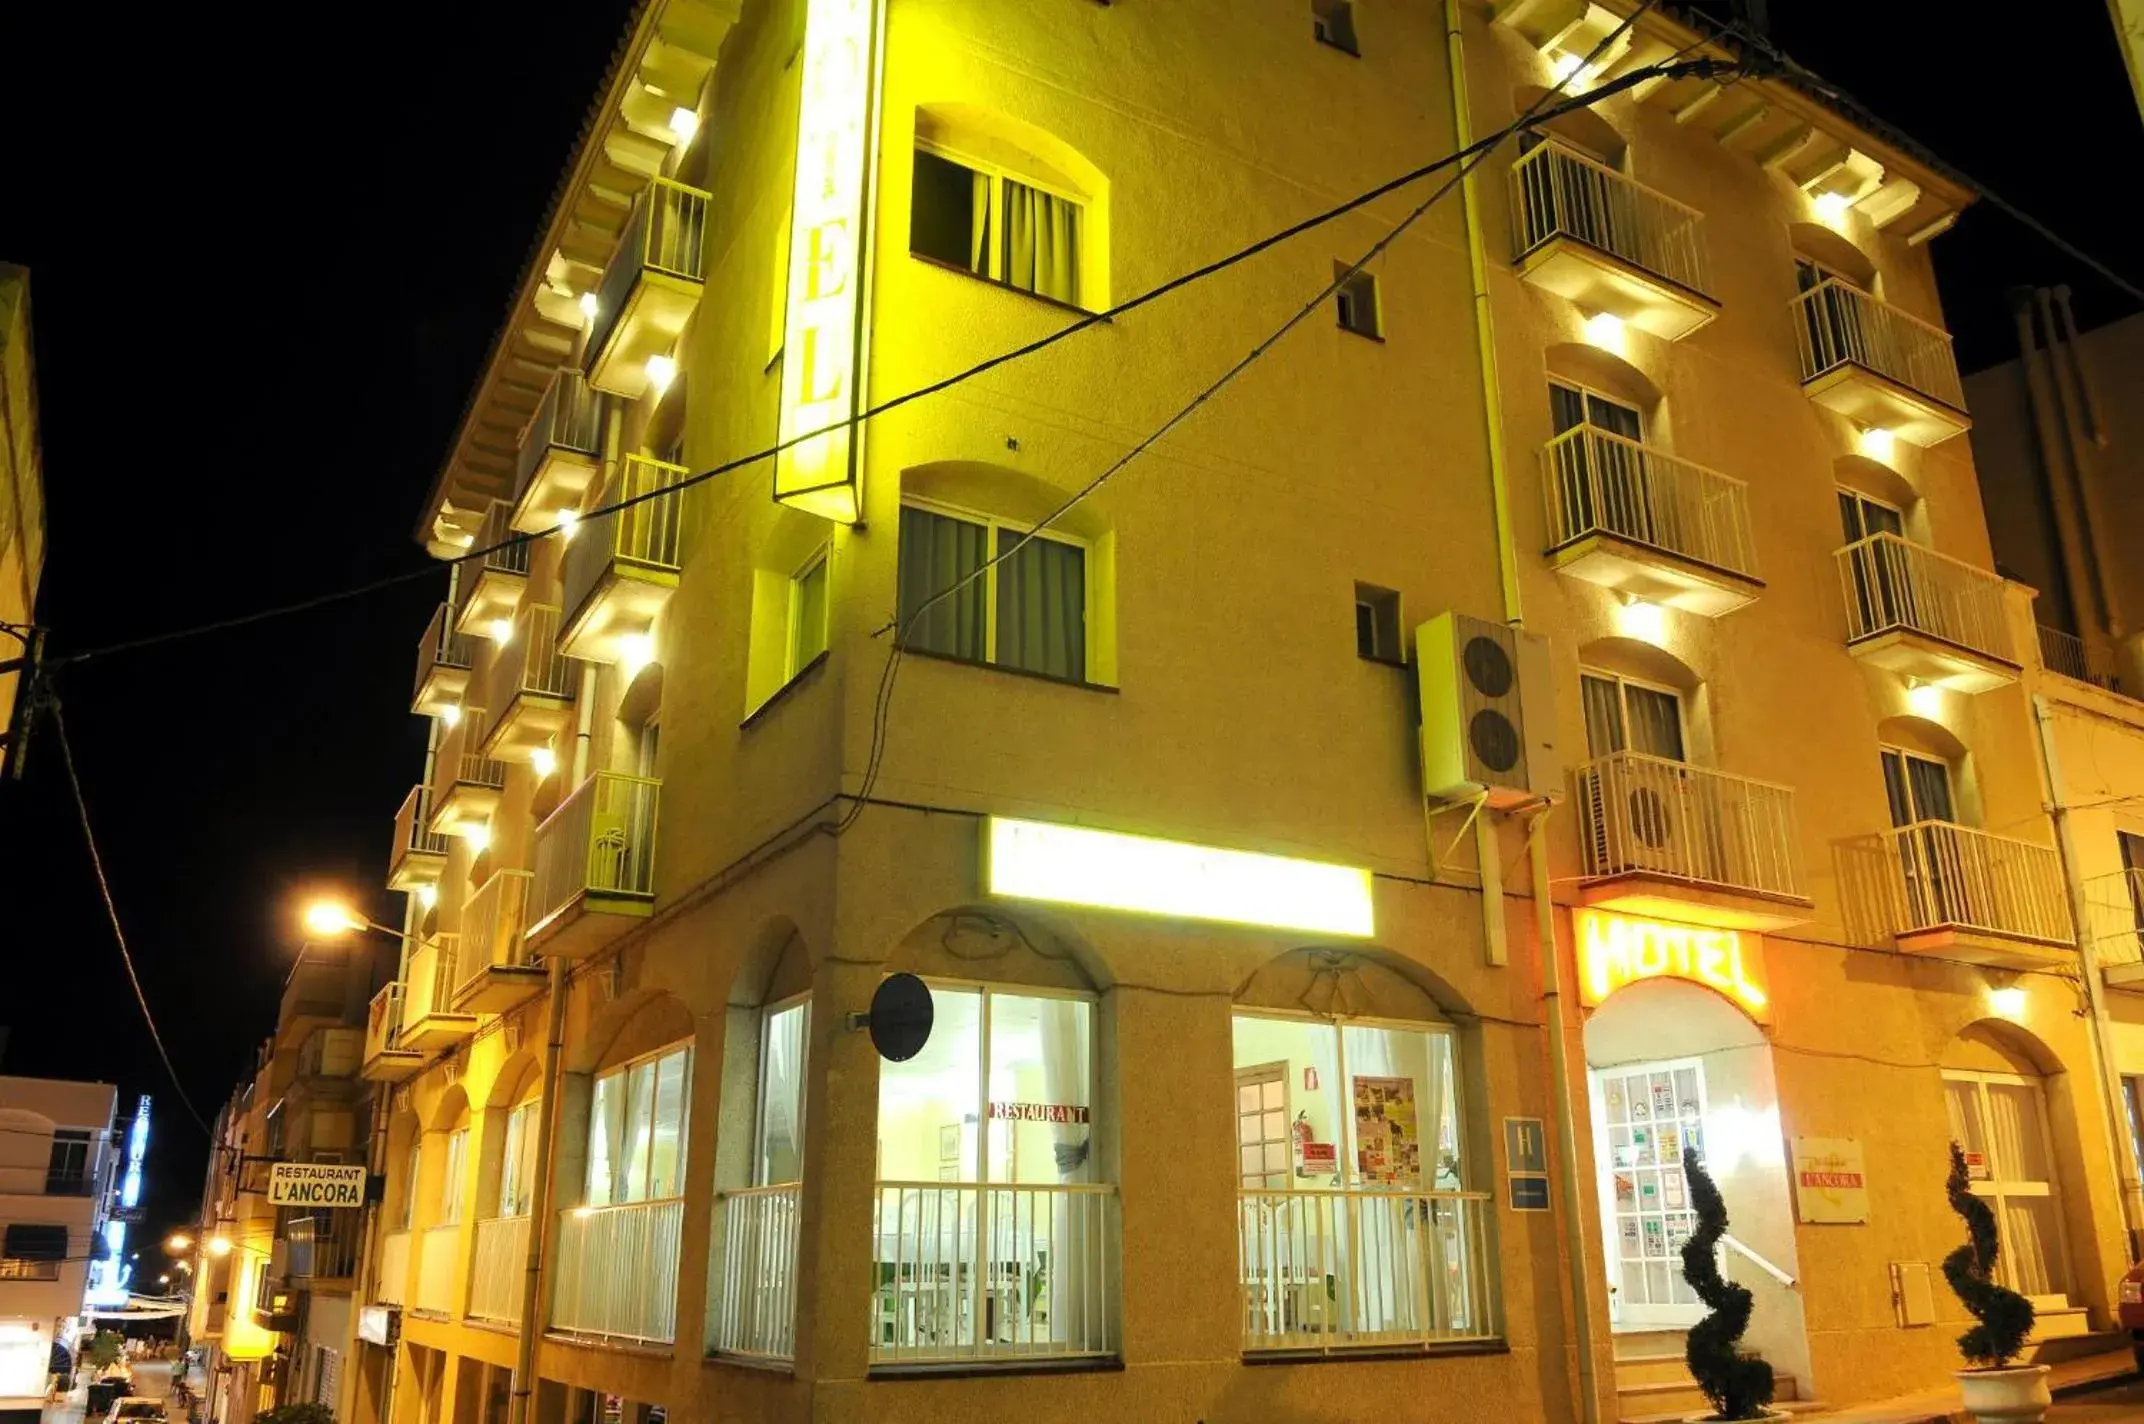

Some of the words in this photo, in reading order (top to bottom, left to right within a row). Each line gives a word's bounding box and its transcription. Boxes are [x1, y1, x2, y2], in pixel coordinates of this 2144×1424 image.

[1584, 911, 1767, 1006] HOTEL
[994, 1102, 1085, 1123] RESTAURANT
[1516, 1126, 1534, 1156] H
[276, 1167, 361, 1180] RESTAURANT
[274, 1182, 358, 1203] L'ANCORA
